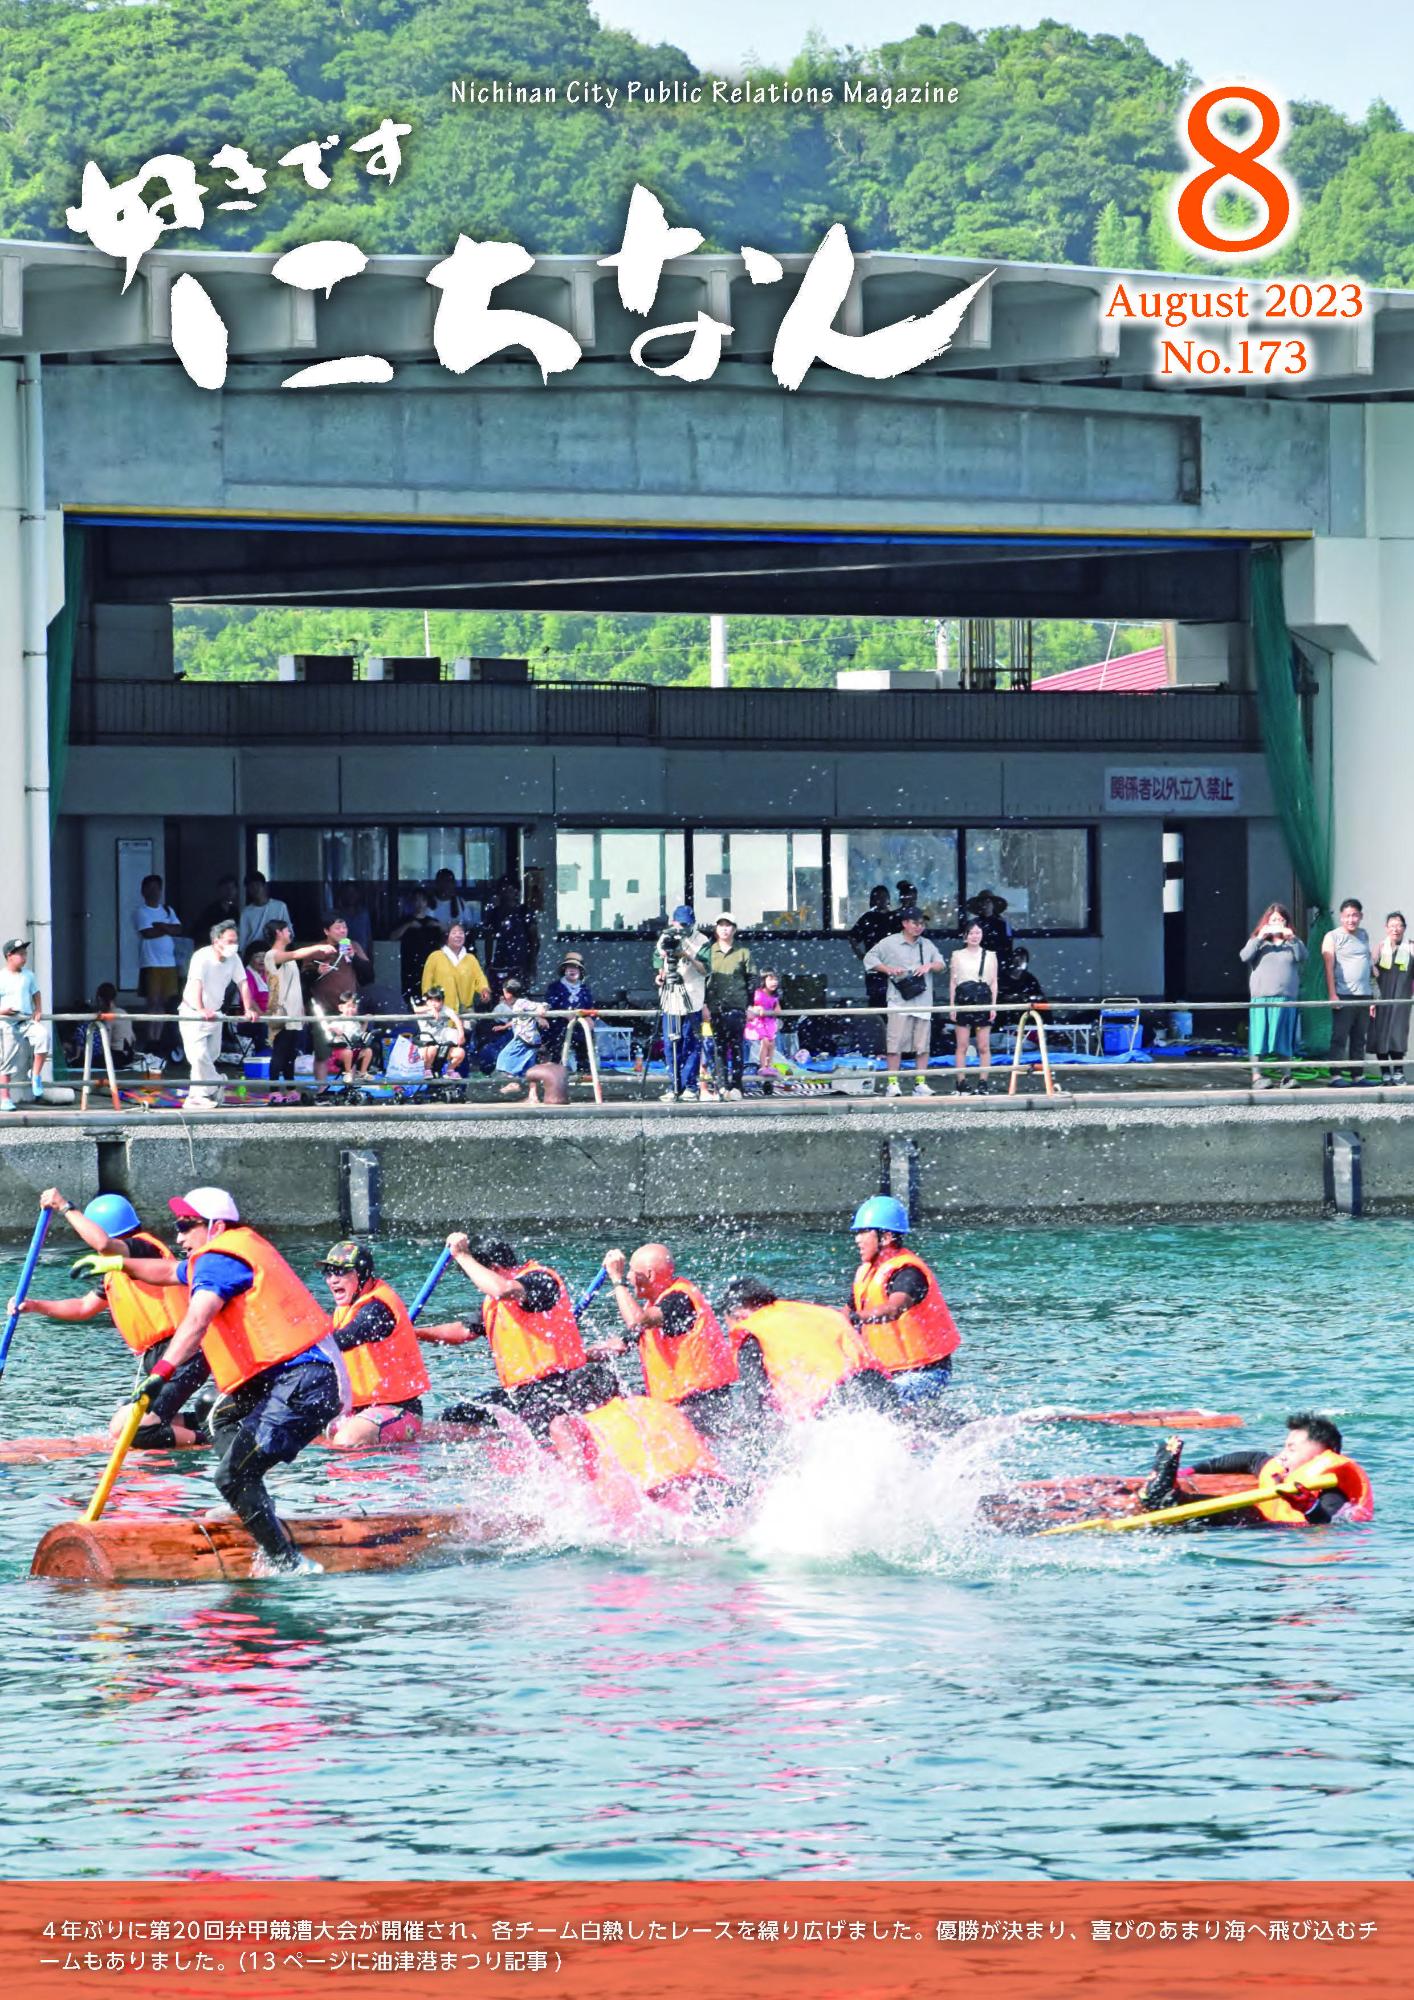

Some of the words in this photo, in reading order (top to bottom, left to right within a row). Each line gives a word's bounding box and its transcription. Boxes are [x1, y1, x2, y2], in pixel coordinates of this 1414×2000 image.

[1111, 776, 1234, 801] 関係者以外立入禁止
